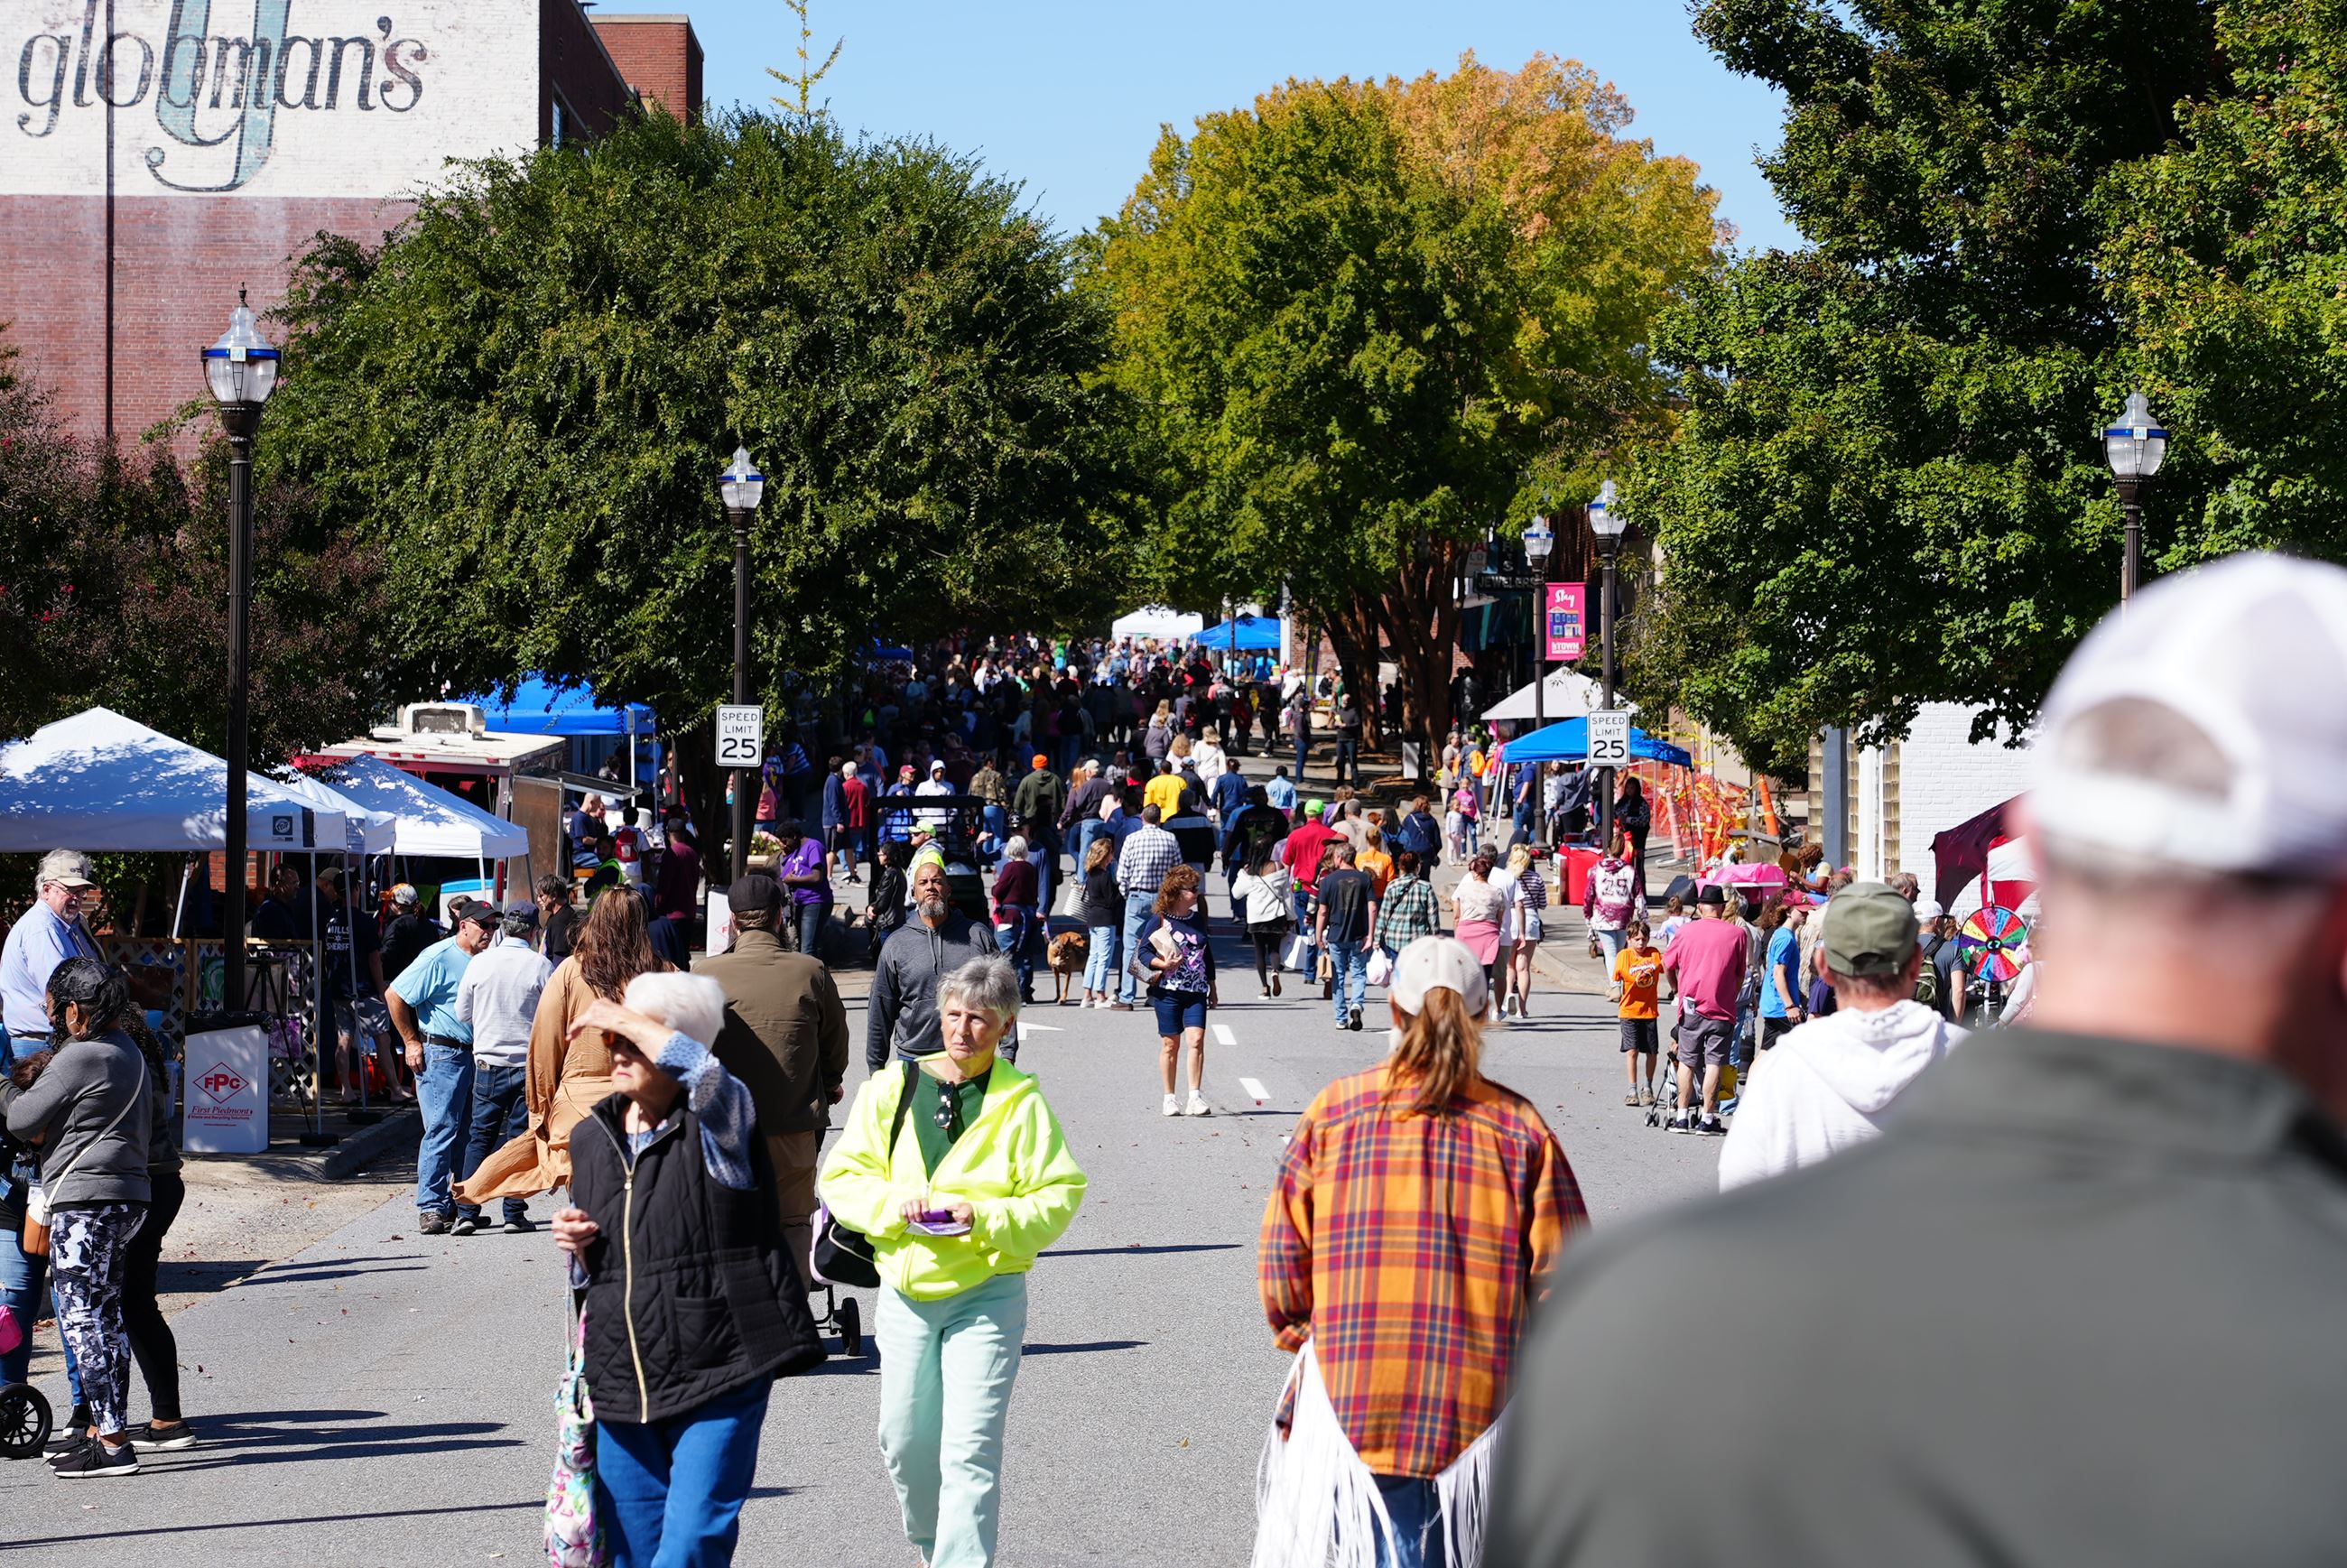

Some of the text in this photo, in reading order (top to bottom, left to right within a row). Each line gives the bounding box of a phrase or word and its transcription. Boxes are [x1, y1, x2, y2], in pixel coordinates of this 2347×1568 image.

[722, 712, 757, 721] SPEED
[1591, 717, 1625, 725] SPEED
[725, 725, 753, 733] LIMIT
[721, 738, 756, 758] 25
[1593, 740, 1625, 758] 25
[1601, 877, 1628, 896] 25
[204, 1073, 241, 1092] FPC
[191, 1105, 249, 1115] First Piedmont
